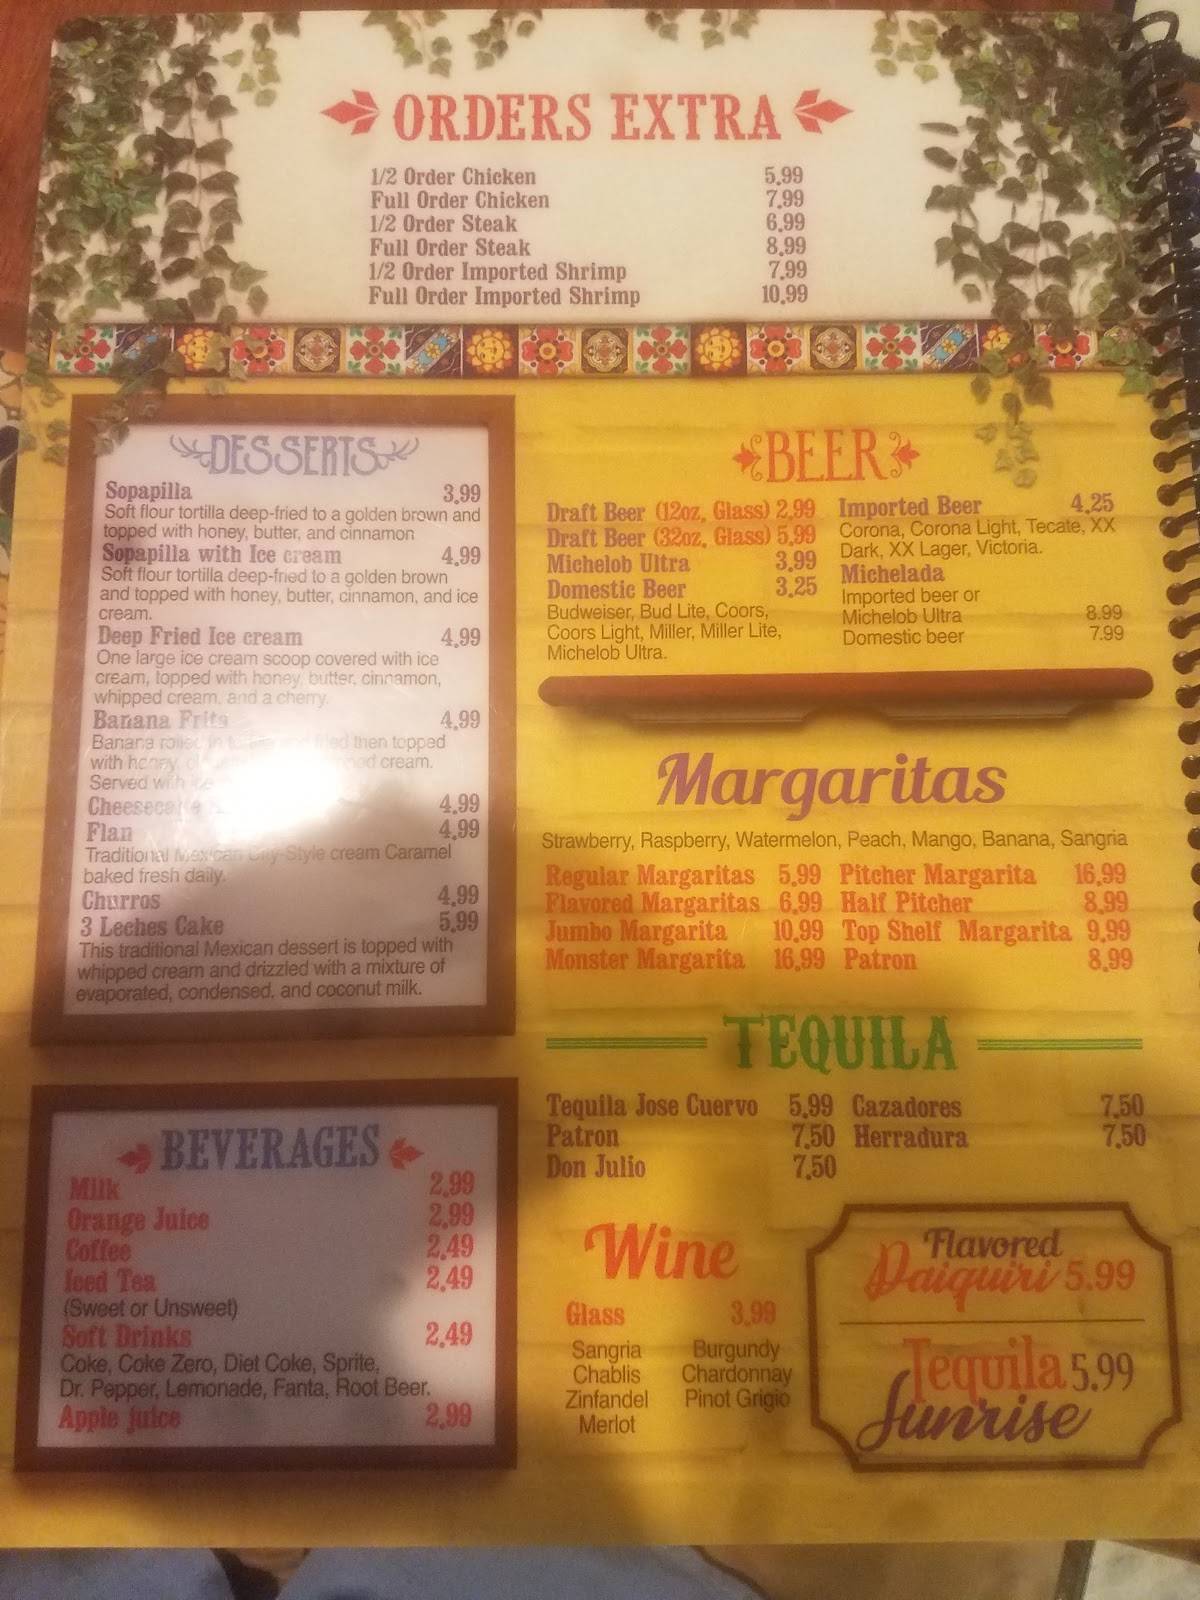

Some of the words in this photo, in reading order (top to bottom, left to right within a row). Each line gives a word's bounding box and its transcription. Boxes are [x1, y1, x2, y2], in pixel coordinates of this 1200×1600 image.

[392, 92, 591, 141] ORDERS
[610, 92, 782, 140] EXTRA
[370, 167, 397, 185] 1/2
[404, 167, 455, 185] Order
[462, 167, 537, 185] Chicken
[764, 165, 804, 186] 5.99
[370, 191, 409, 210] Full
[417, 191, 468, 210] Order
[475, 191, 550, 209] Chicken
[766, 189, 805, 209] 7.99
[369, 215, 396, 233] 1/2
[403, 215, 455, 233] Order
[462, 215, 519, 233] Steak
[766, 213, 806, 234] 6.99
[369, 238, 408, 256] Full
[416, 238, 468, 256] Order
[475, 238, 532, 256] Steak
[766, 236, 807, 257] 8.99
[368, 262, 395, 280] 1/2
[402, 262, 454, 281] Order
[462, 262, 548, 284] Imported
[556, 262, 627, 283] Shrimp
[767, 260, 808, 282] 7.99
[368, 285, 408, 305] Full
[416, 285, 468, 305] Order
[475, 285, 561, 307] Imported
[570, 285, 641, 307] Shrimp
[761, 285, 809, 306] 10.99
[209, 434, 377, 475] DESSERTS
[766, 429, 887, 482] BEER
[105, 481, 193, 504] Sopapilla
[442, 484, 481, 506] 3.99
[1071, 492, 1114, 515] 4.25
[104, 504, 136, 520] Soft
[140, 504, 175, 524] flour
[176, 504, 225, 524] tortilla
[229, 505, 308, 525] deep-fried
[312, 507, 327, 522] to
[331, 508, 340, 521] a
[345, 506, 397, 525] golden
[402, 506, 447, 523] brown
[453, 507, 481, 523] and
[839, 497, 929, 520] Imported
[937, 494, 983, 516] Beer
[910, 519, 971, 537] Corona
[1088, 517, 1116, 533] XX
[102, 543, 190, 566] Sopapilla
[198, 545, 241, 564] with
[249, 545, 276, 564] Ice
[284, 549, 342, 569] cream
[441, 546, 481, 568] 4.99
[546, 554, 632, 574] Michelob
[640, 553, 691, 574] Ultra
[775, 550, 817, 572] 3.99
[546, 579, 635, 600] Domestic
[643, 579, 687, 600] Beer
[775, 576, 818, 599] 3.25
[639, 602, 672, 620] Bud
[842, 608, 917, 626] Michelob
[923, 606, 963, 624] Ultra
[1086, 604, 1123, 621] 8.99
[98, 625, 142, 649] Deep
[150, 626, 201, 646] Fried
[208, 627, 236, 645] Ice
[243, 631, 304, 646] cream
[440, 627, 481, 649] 4.99
[843, 628, 921, 646] Domestic
[926, 628, 965, 645] beer
[1089, 625, 1124, 641] 7.99
[657, 751, 1007, 821] Margaritas
[86, 822, 133, 843] Flan
[438, 818, 481, 841] 4.99
[1061, 829, 1129, 851] Sangria
[545, 864, 629, 891] Regular
[637, 864, 756, 891] Margaritas
[778, 863, 821, 888] 5.99
[82, 890, 161, 911] Churros
[437, 884, 480, 907] 4.99
[840, 891, 887, 915] Half
[896, 891, 973, 915] Pitcher
[1083, 890, 1129, 915] 8.99
[80, 915, 92, 937] 3
[100, 915, 167, 937] Leches
[175, 915, 224, 936] Cake
[438, 911, 480, 934] 5.99
[545, 920, 612, 943] Jumbo
[619, 919, 728, 946] Margarita
[773, 918, 824, 943] 10.99
[843, 947, 917, 970] Patron
[1088, 947, 1133, 973] 8.99
[280, 981, 312, 999] and
[316, 979, 382, 998] coconut
[721, 1013, 959, 1076] TEQUILA
[546, 1093, 629, 1121] Tequila
[635, 1093, 679, 1117] Jose
[686, 1093, 758, 1117] Cuervo
[788, 1093, 834, 1121] 5.99
[852, 1093, 962, 1118] Cazadores
[1099, 1092, 1145, 1120] 7.50
[160, 1123, 380, 1172] BEVERAGES
[546, 1125, 620, 1147] Patron
[791, 1123, 836, 1151] 7.50
[853, 1124, 968, 1149] Herradura
[1102, 1123, 1147, 1151] 7.50
[546, 1155, 585, 1179] Don
[595, 1154, 646, 1179] Julio
[792, 1154, 837, 1182] 7.50
[65, 1238, 132, 1264] Coffee
[426, 1234, 475, 1262] 2.49
[584, 1222, 740, 1281] Wine
[923, 1226, 1063, 1260] Flavored
[863, 1240, 1060, 1314] Daiquiri
[1064, 1258, 1136, 1291] 5.99
[63, 1299, 126, 1321] (Sweet
[127, 1299, 151, 1320] or
[154, 1299, 238, 1321] Unsweet)
[565, 1301, 625, 1328] Glass
[730, 1300, 776, 1329] 3.99
[572, 1339, 642, 1365] Sangria
[693, 1339, 780, 1363] Burgundy
[118, 1354, 166, 1375] Coke
[223, 1353, 260, 1375] Diet
[573, 1364, 641, 1384] Chablis
[681, 1364, 793, 1387] Chardonnay
[903, 1335, 1067, 1408] Tequila
[1070, 1351, 1135, 1392] 5.99
[565, 1389, 649, 1410] Zinfandel
[685, 1389, 731, 1409] Pinot
[736, 1389, 791, 1414] Grigio
[856, 1370, 1092, 1453] Sunrise
[579, 1414, 636, 1434] Merlot
